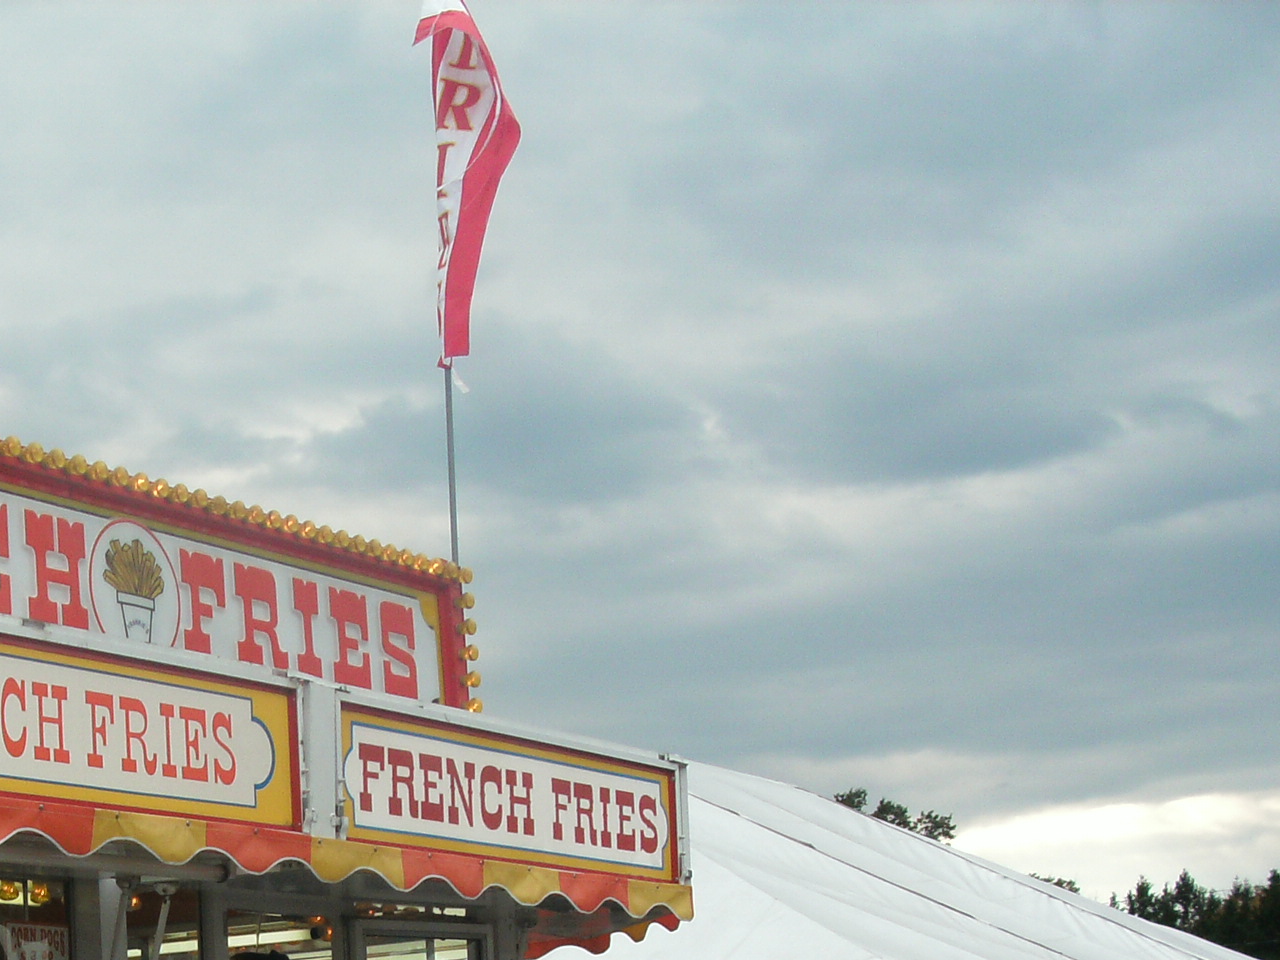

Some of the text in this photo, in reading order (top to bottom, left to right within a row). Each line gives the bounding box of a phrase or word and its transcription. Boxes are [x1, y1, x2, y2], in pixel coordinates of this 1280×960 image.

[178, 547, 419, 700] FRIES
[84, 690, 238, 785] FRIES
[357, 742, 659, 855] FRENCH FRIES
[10, 926, 66, 957] CORN DOGS
